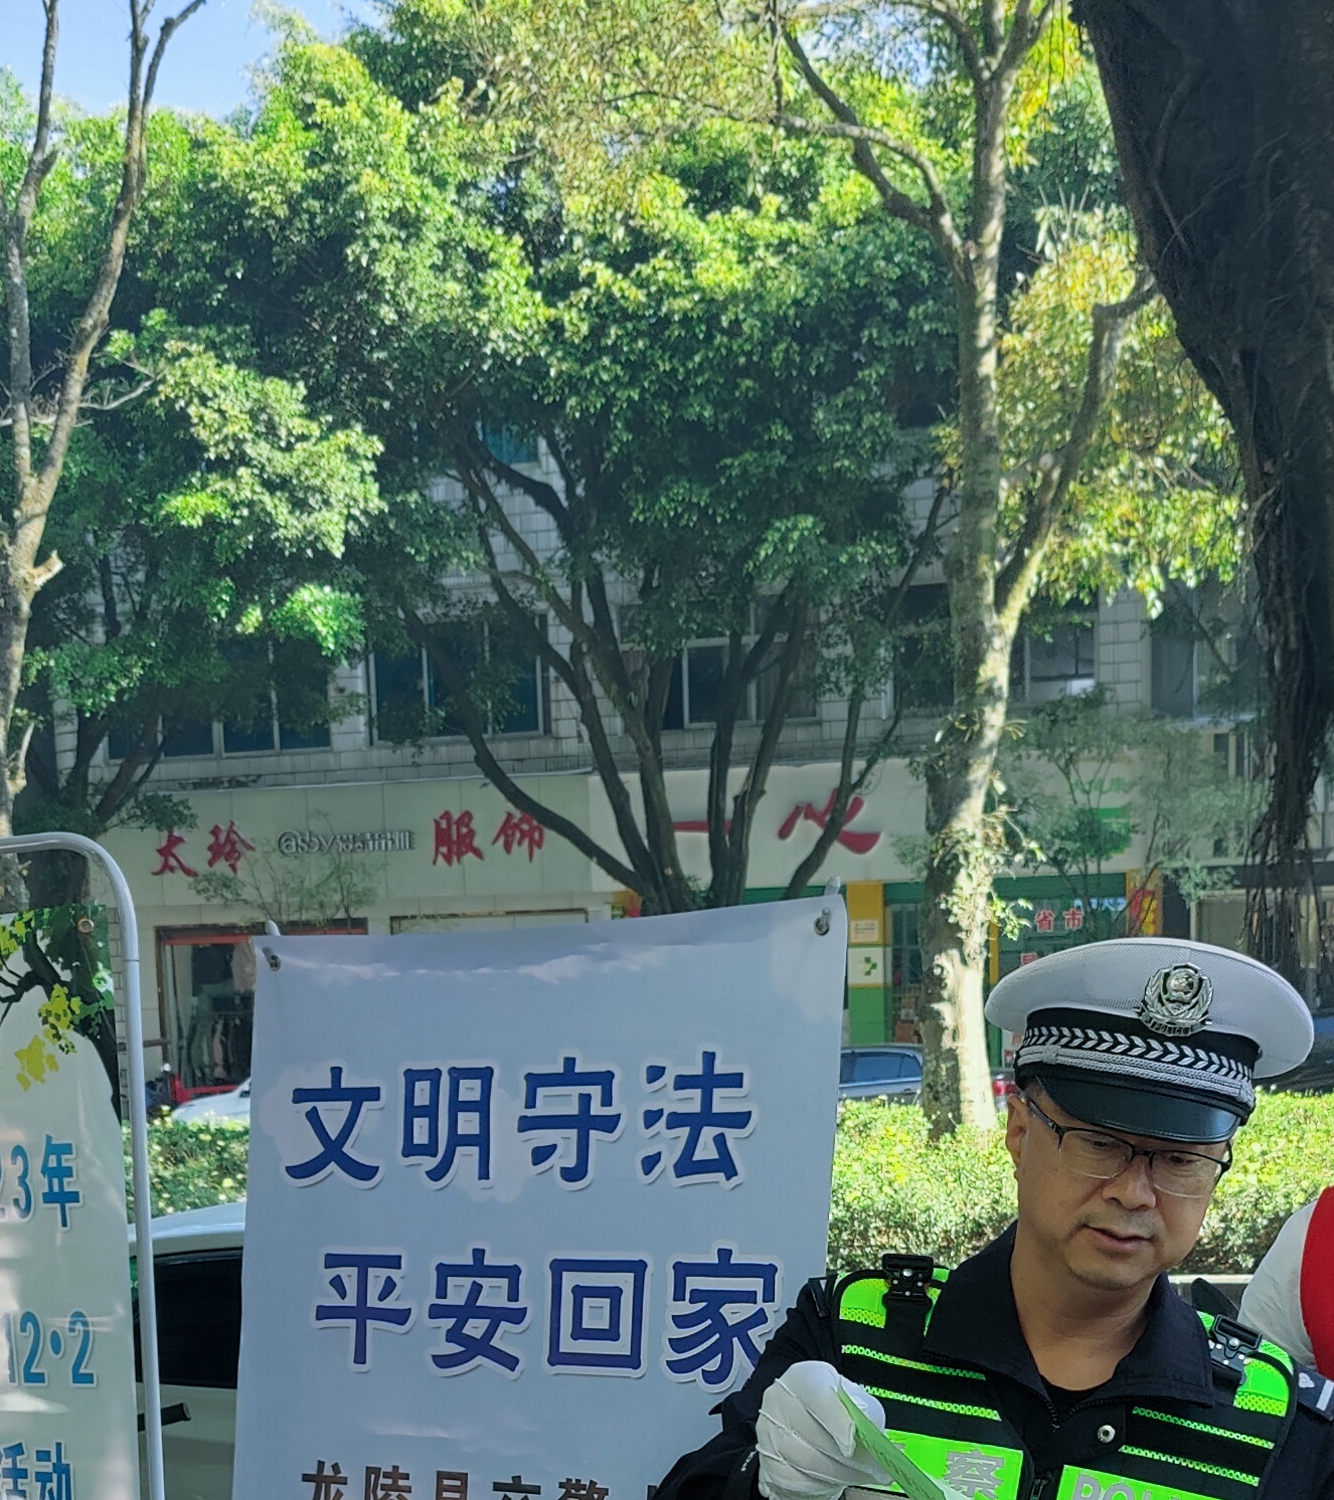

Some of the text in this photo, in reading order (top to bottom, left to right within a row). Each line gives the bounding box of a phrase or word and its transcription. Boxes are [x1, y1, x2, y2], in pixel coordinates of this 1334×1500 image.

[432, 809, 545, 866] 服饰
[284, 1050, 753, 1184] 文明守法
[315, 1247, 780, 1387] 平安回家
